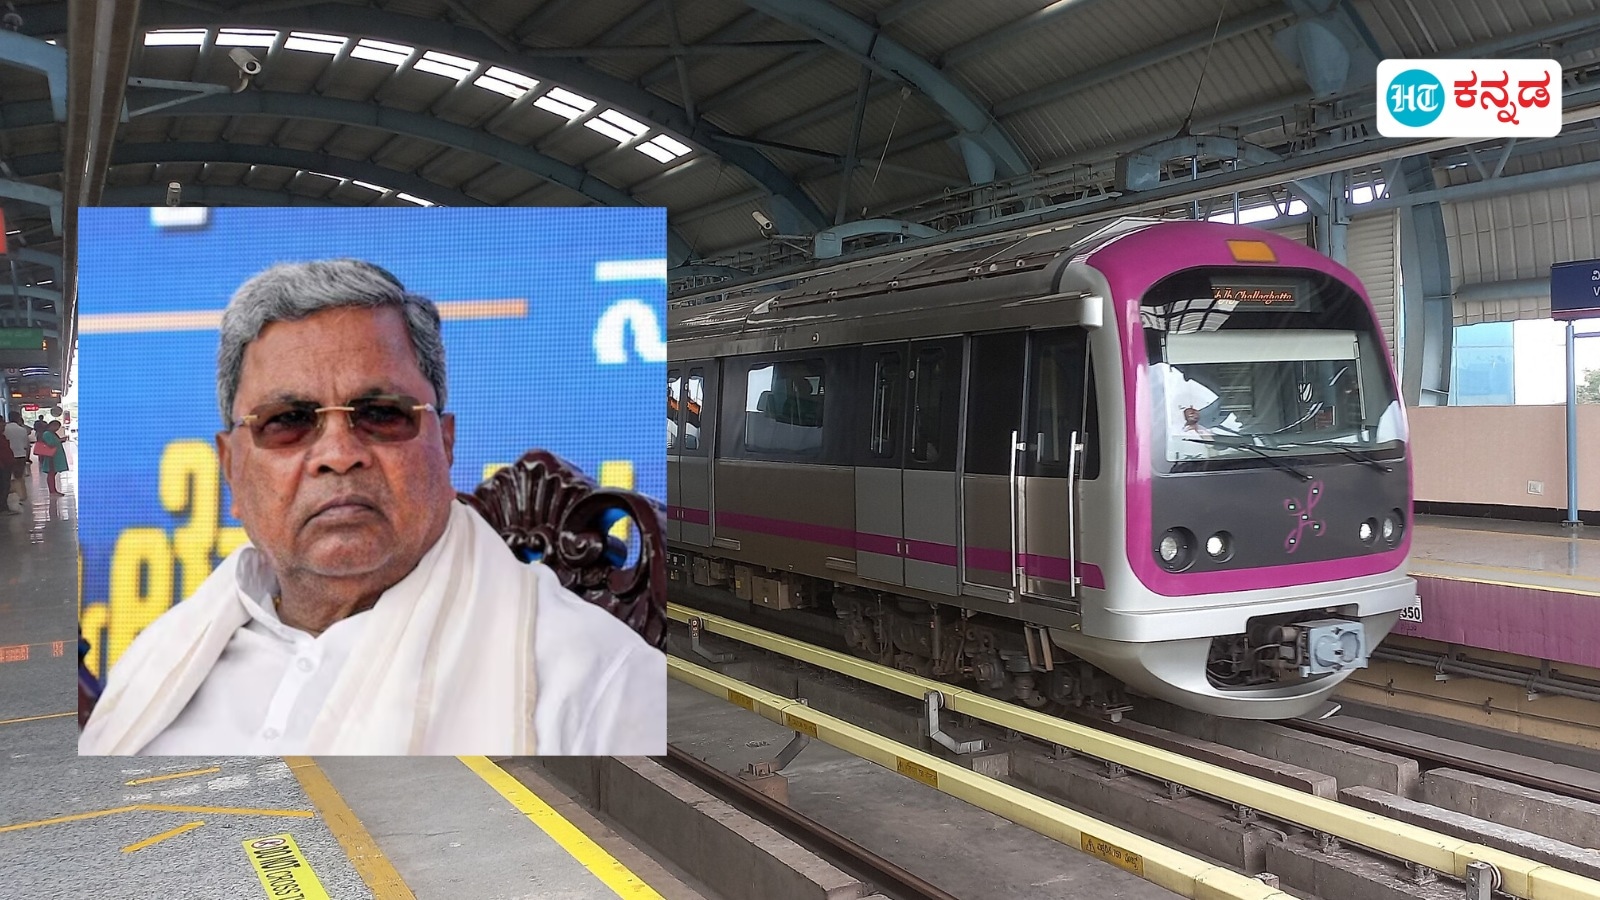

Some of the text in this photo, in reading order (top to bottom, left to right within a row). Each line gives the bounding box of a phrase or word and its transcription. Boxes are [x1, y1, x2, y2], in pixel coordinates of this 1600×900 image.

[253, 845, 293, 859] DO
[259, 855, 301, 873] NOT
[265, 871, 302, 896] CROSS
